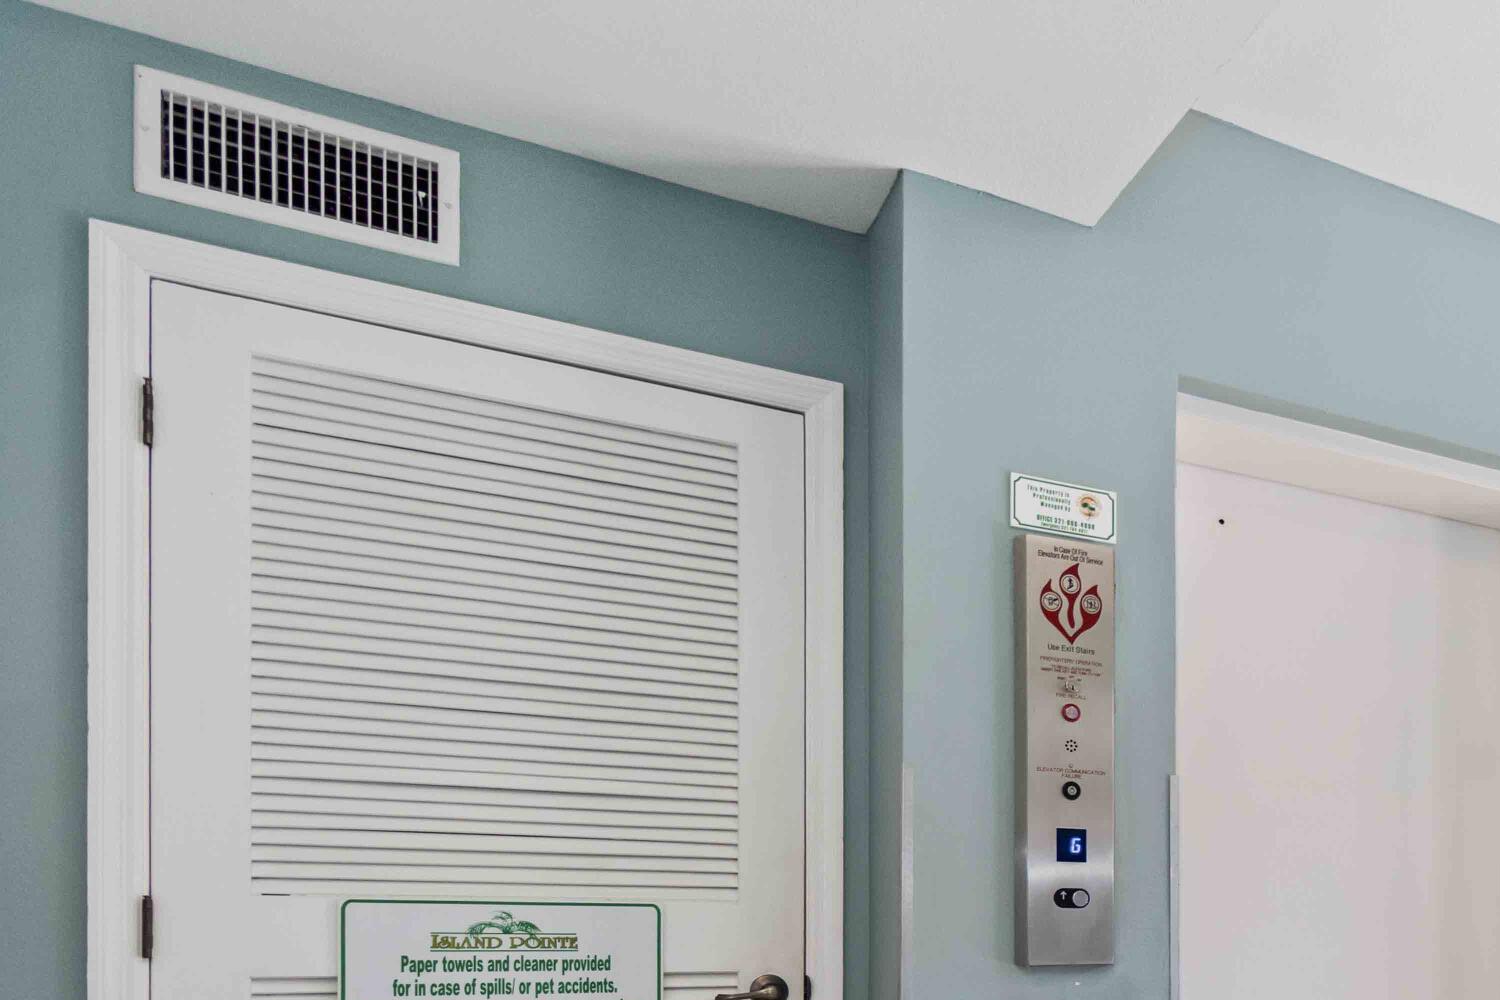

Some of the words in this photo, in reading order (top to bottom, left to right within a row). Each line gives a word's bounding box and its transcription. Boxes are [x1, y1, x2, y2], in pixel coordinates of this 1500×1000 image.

[1037, 549, 1060, 559] Elevators
[1086, 557, 1103, 565] Service
[1059, 546, 1071, 554] Case
[1047, 643, 1060, 651] Use
[1061, 644, 1075, 652] Exit
[1076, 646, 1096, 656] Stairs
[1064, 767, 1106, 777] COMMUNICATION
[1070, 837, 1082, 853] G
[430, 934, 503, 950] ISLAND
[509, 935, 578, 950] POINTE
[400, 955, 438, 977] Paper
[443, 955, 483, 973] towels
[488, 955, 510, 972] and
[513, 955, 558, 972] cleaner
[562, 954, 611, 975] provided
[392, 979, 411, 996] for
[415, 978, 426, 996] in
[430, 981, 460, 996] case
[464, 978, 477, 996] of
[519, 981, 531, 995] or
[535, 978, 554, 998] pet
[558, 977, 618, 994] accidents.
